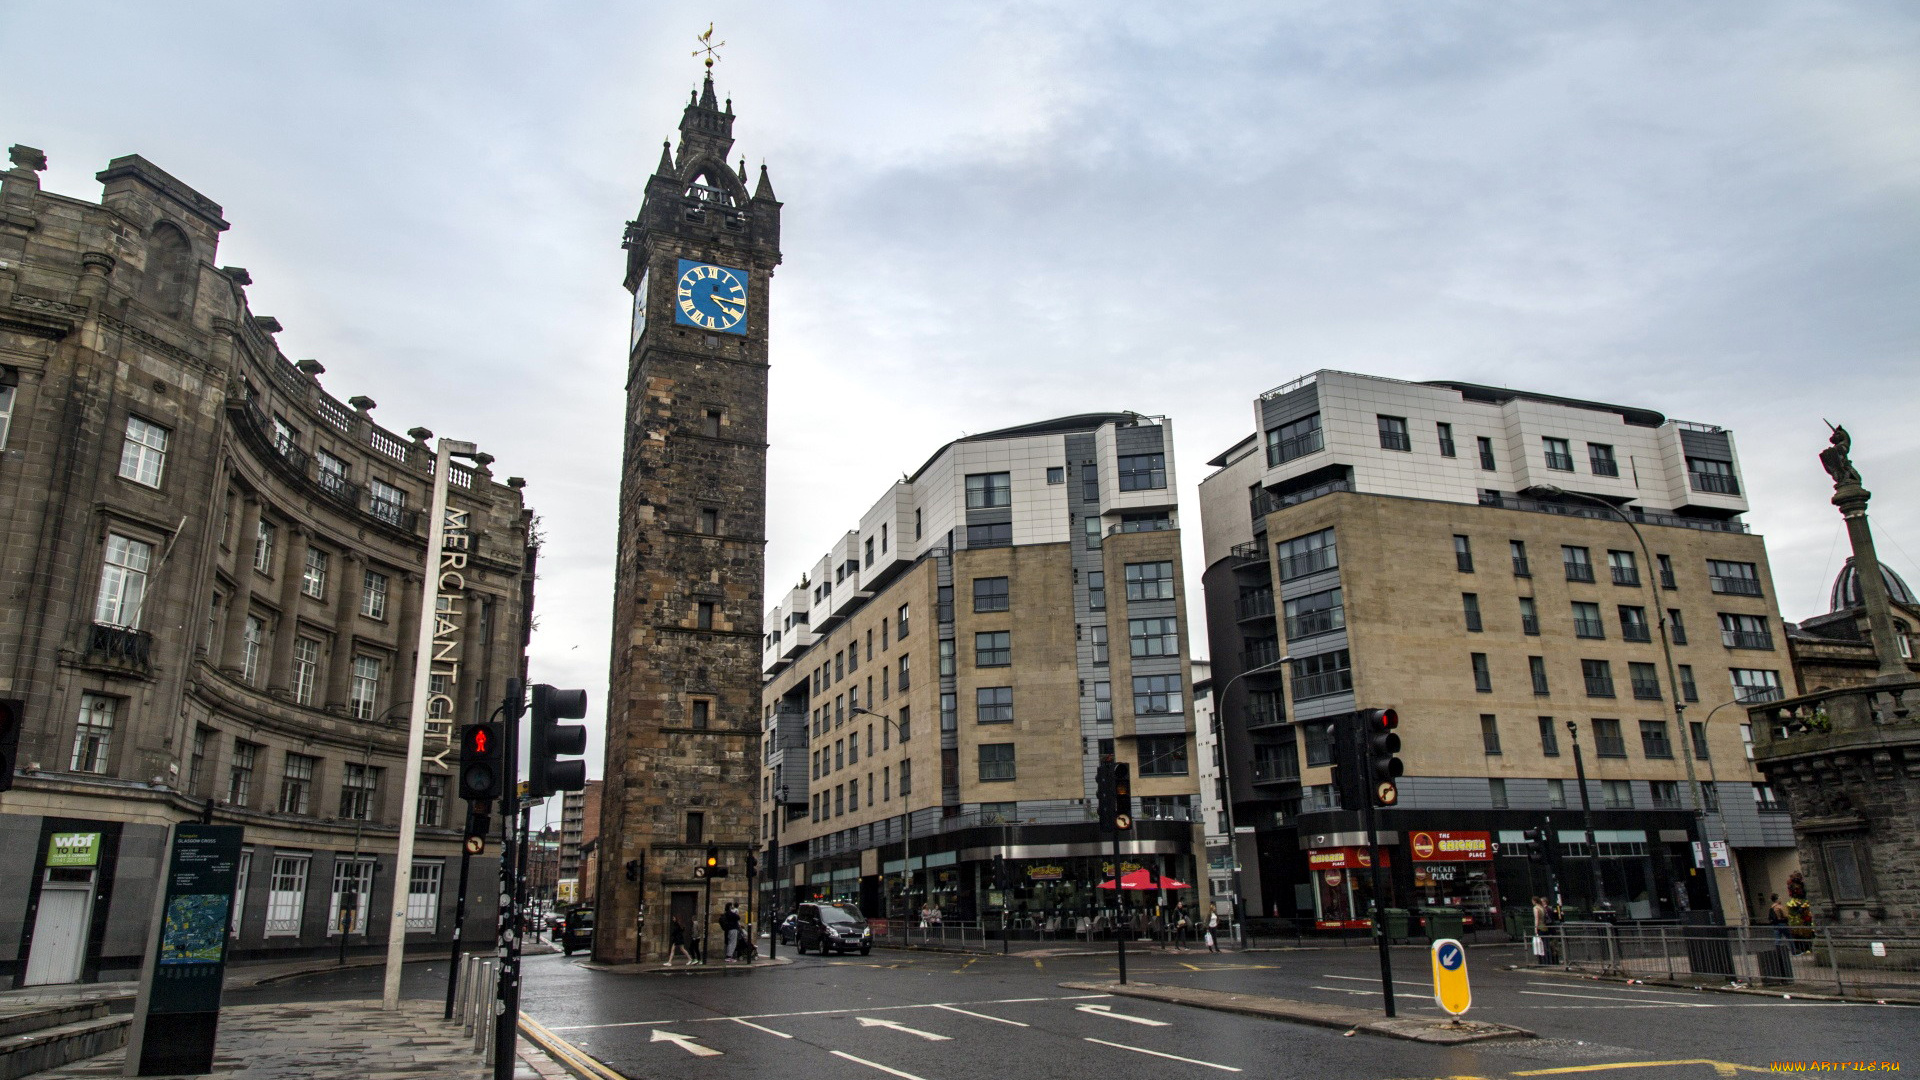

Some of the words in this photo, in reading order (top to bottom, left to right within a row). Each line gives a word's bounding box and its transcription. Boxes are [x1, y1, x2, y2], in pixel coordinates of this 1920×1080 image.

[429, 505, 469, 685] MERCHANT
[421, 694, 454, 771] CITY
[55, 833, 96, 847] wbf
[1438, 839, 1486, 852] CHICKEN
[56, 847, 69, 855] TO
[73, 846, 90, 854] LET
[1426, 865, 1458, 873] CHICKEN
[1431, 872, 1454, 880] PLACE
